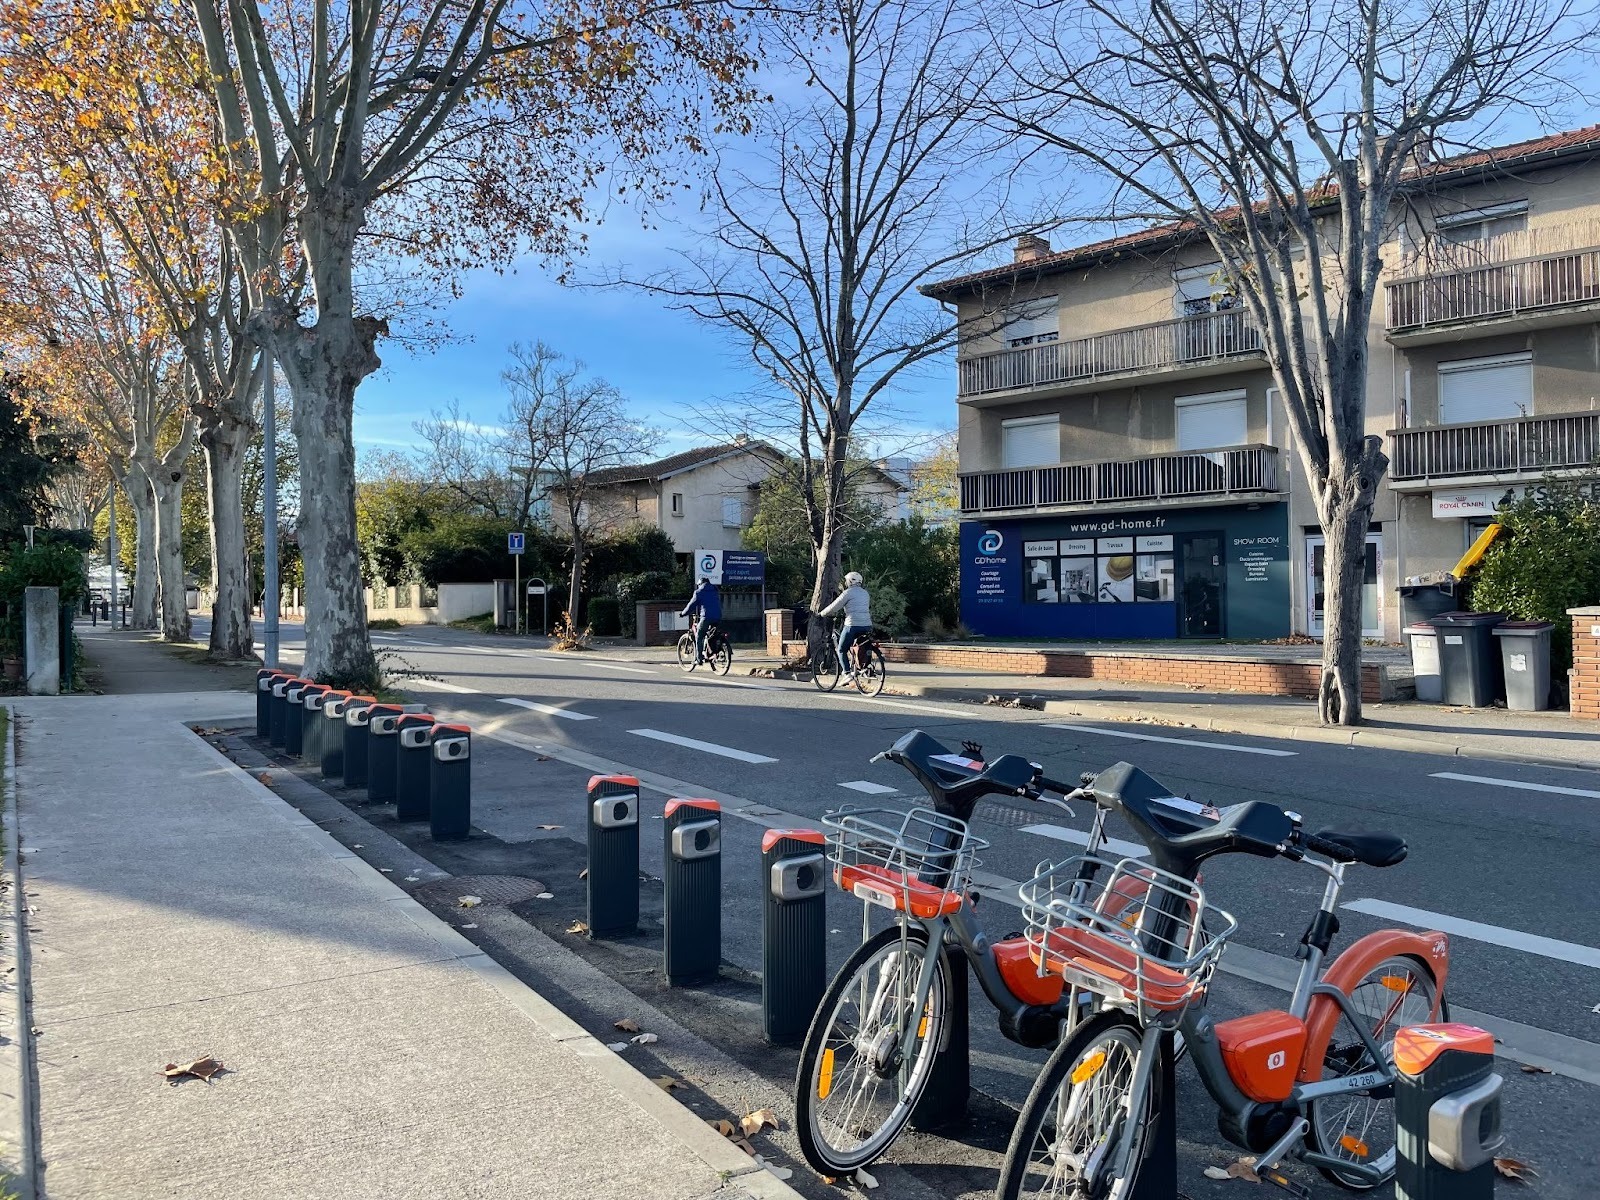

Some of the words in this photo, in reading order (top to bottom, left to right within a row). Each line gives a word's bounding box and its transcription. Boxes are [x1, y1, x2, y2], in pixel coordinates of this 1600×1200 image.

[1070, 516, 1166, 533] www.gd-home.fr
[1233, 537, 1256, 546] SHOW
[1257, 536, 1280, 544] ROOM
[1348, 1077, 1359, 1087] 42
[1359, 1074, 1376, 1086] 260
